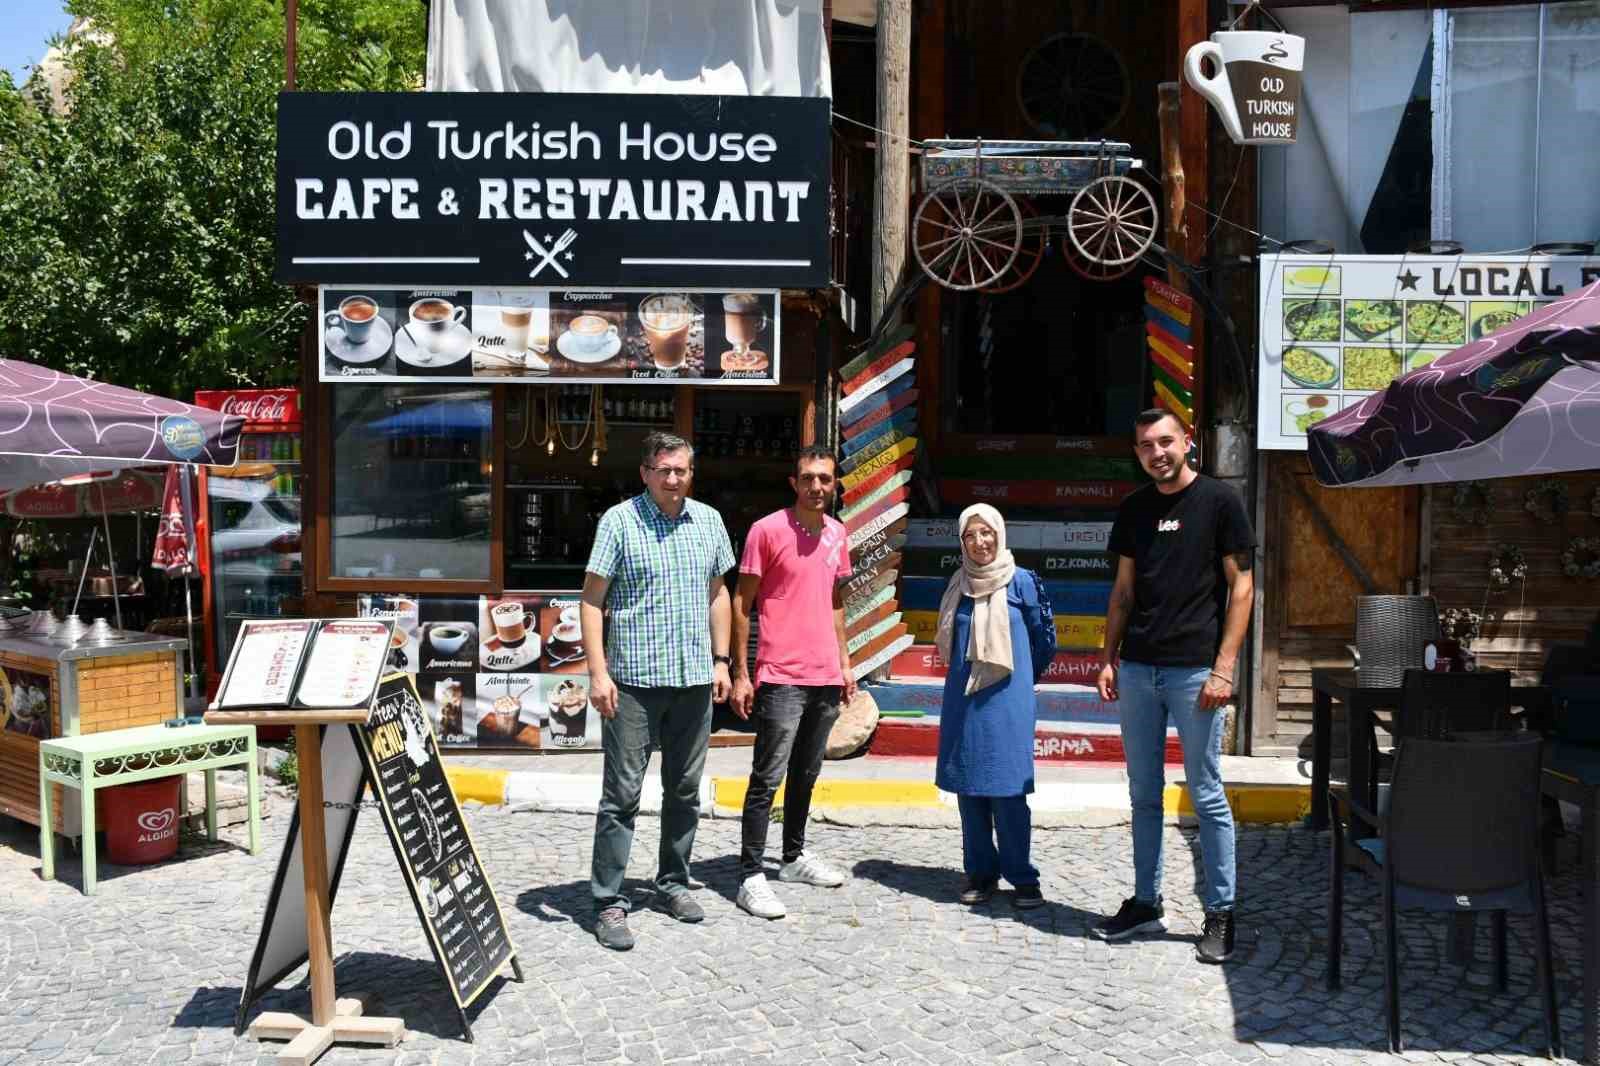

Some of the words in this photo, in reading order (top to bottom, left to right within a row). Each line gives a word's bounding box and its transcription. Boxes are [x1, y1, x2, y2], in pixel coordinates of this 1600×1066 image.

[1260, 77, 1284, 94] OLD
[1246, 99, 1295, 116] TURKISH
[328, 121, 412, 161] Old
[428, 121, 601, 161] Turkish
[619, 121, 778, 163] House
[1253, 121, 1292, 138] HOUSE
[295, 178, 420, 220] CAFE
[438, 187, 460, 216] &
[478, 178, 811, 223] RESTAURANT
[1432, 267, 1564, 297] LOCAL
[478, 335, 506, 347] Latte
[858, 531, 888, 557] SPAIN
[853, 545, 893, 575] KOREA
[848, 566, 880, 591] ITALY
[487, 654, 515, 667] Latte
